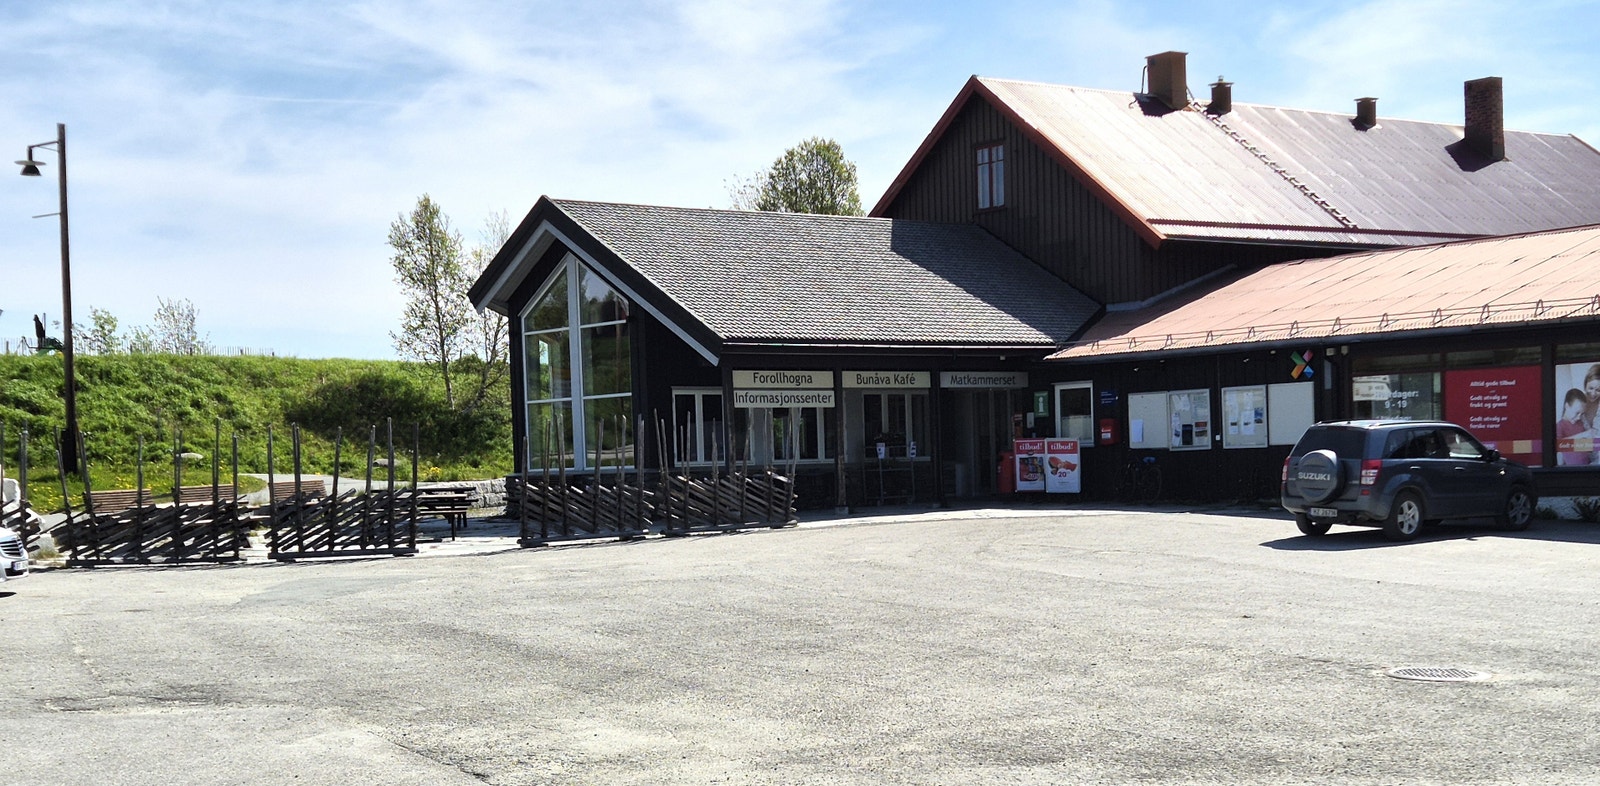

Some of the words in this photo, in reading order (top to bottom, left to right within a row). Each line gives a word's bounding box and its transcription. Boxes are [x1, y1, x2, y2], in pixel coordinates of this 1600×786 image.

[753, 372, 813, 386] Forollhogna
[856, 373, 891, 385] Bunåva
[894, 373, 916, 385] Kafé
[950, 374, 1016, 385] Matkammerset
[735, 392, 832, 406] Informasjonssenter
[1385, 400, 1391, 409] 9
[1397, 400, 1408, 409] 19
[1020, 442, 1043, 450] tilbud!
[1051, 442, 1074, 450] tilbud!
[1298, 472, 1331, 480] SUZUKI
